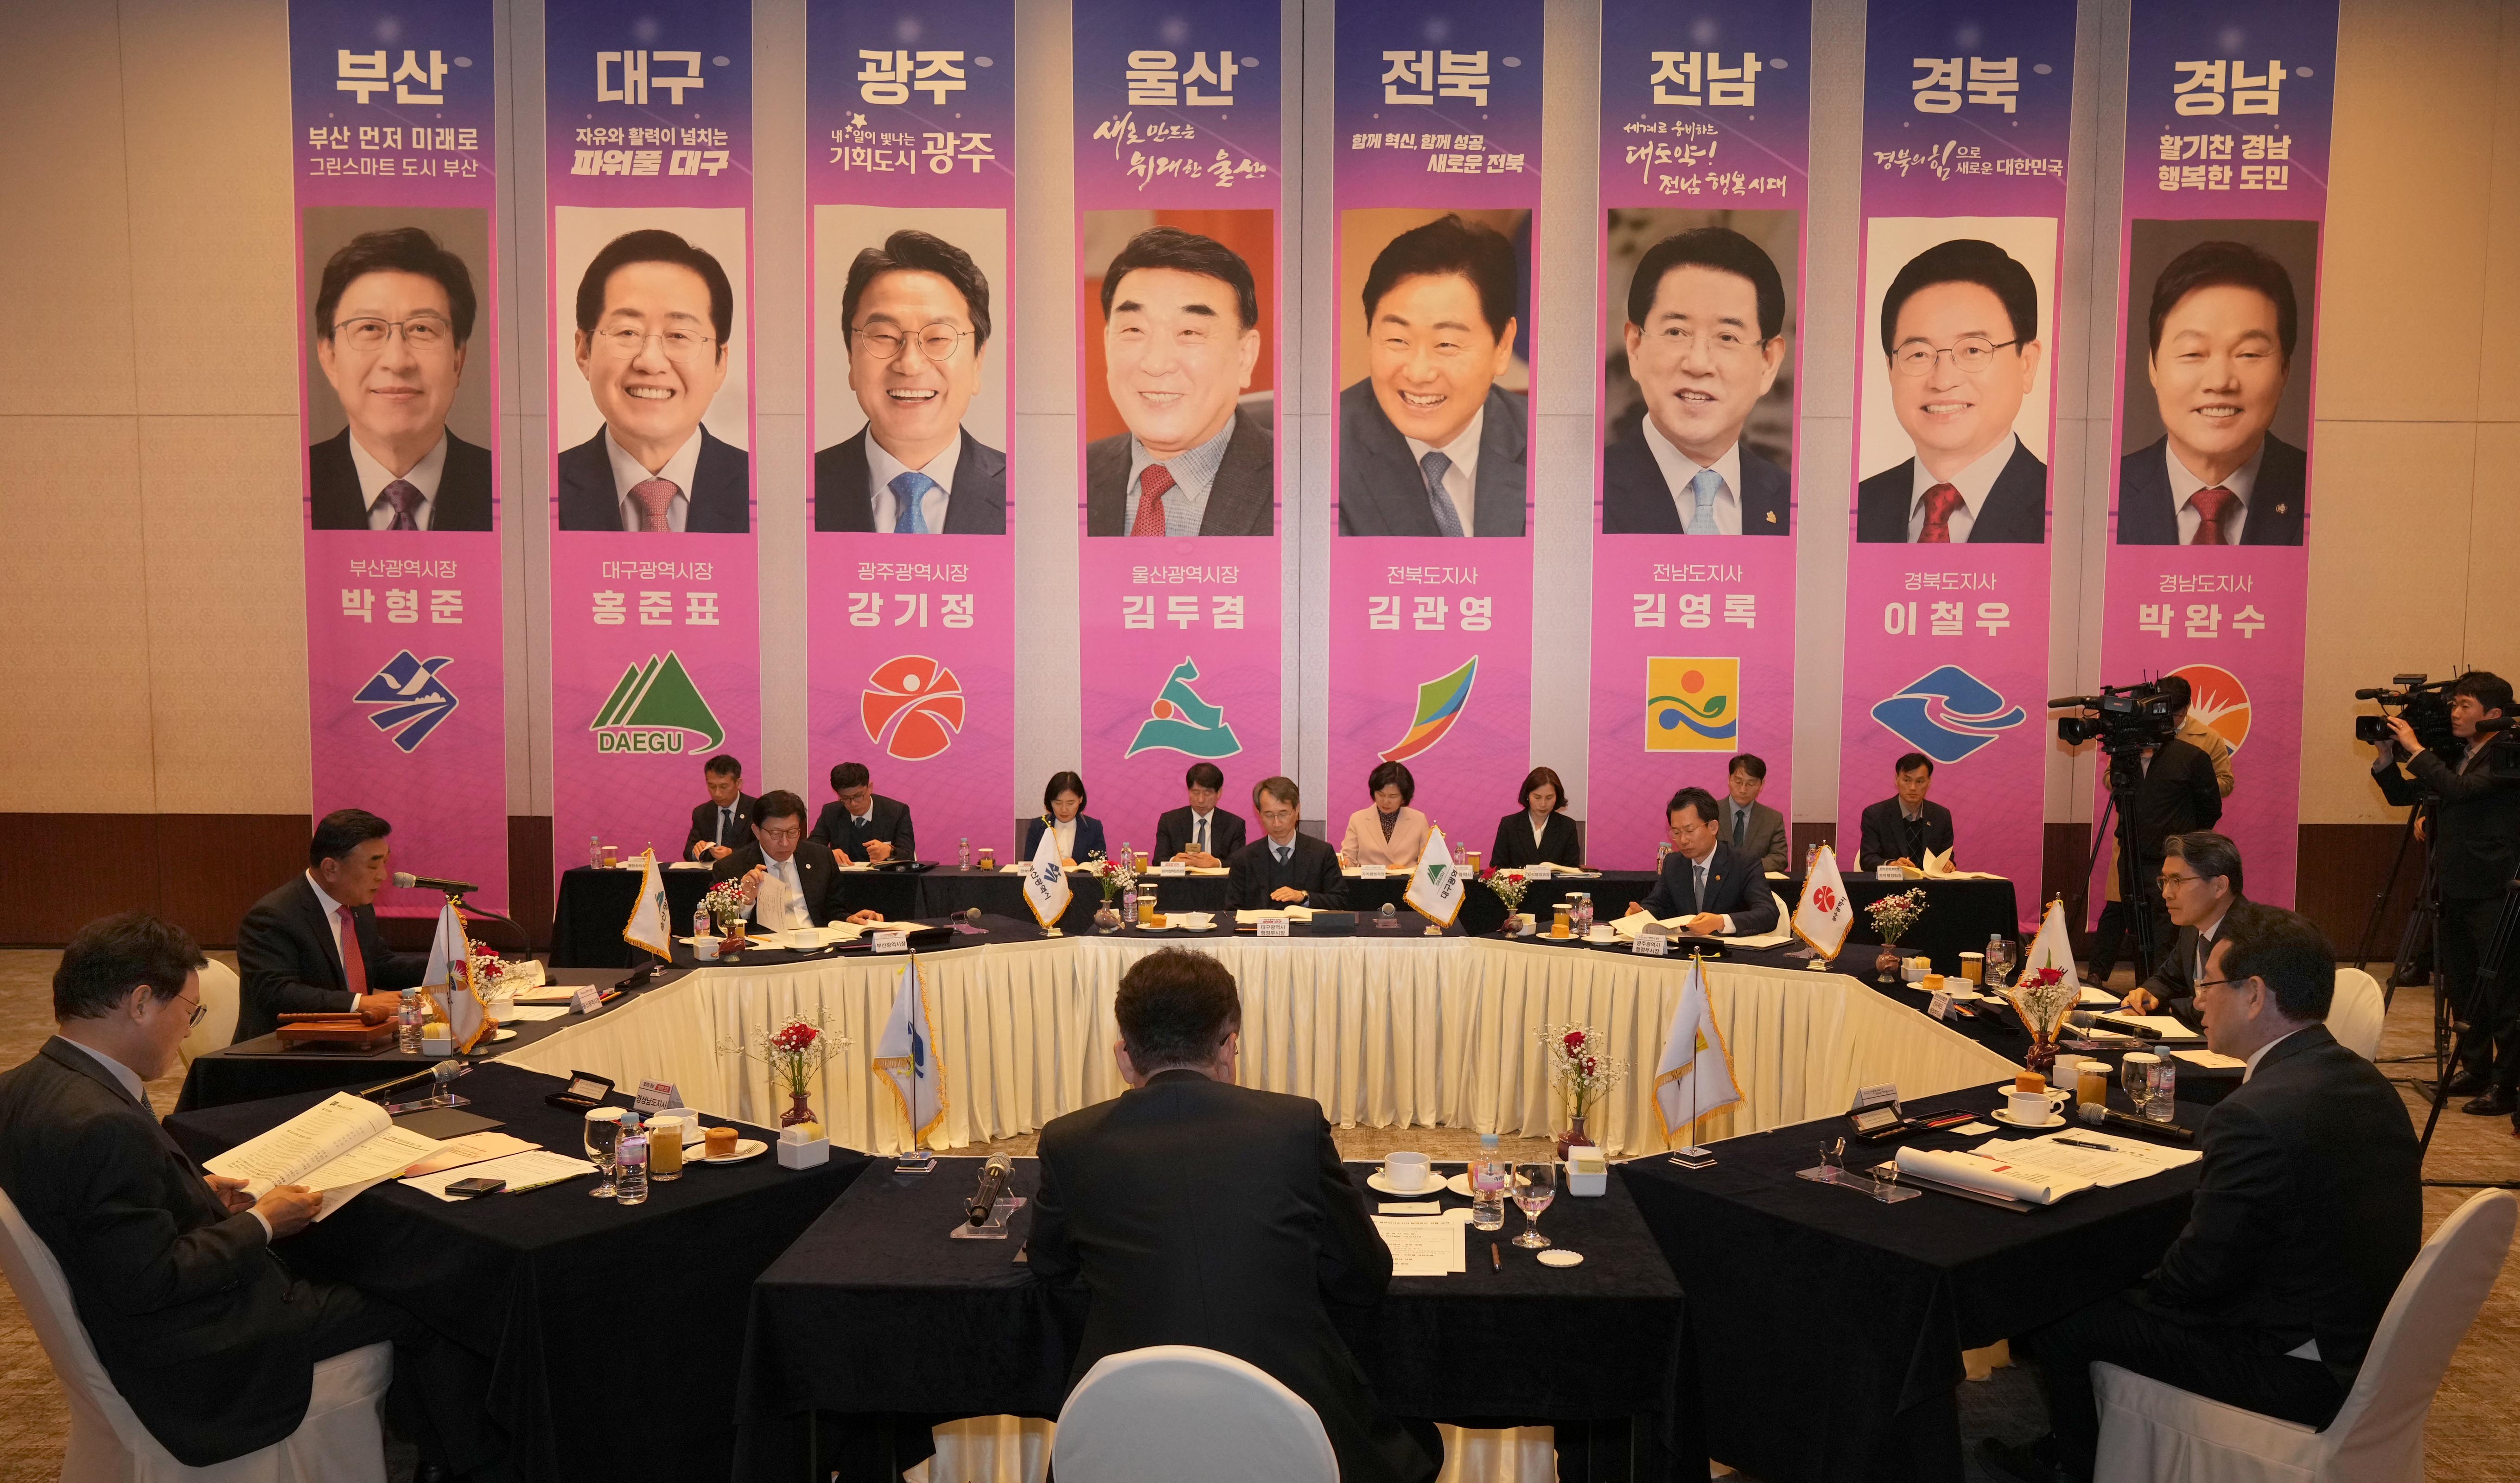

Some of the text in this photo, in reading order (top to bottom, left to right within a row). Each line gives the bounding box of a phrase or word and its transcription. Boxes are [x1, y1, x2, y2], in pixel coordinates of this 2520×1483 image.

[337, 50, 447, 104] 부산
[597, 51, 704, 104] 대구
[858, 50, 966, 104] 광주
[1126, 51, 1238, 105] 울산
[1382, 51, 1489, 106] 전북
[1651, 51, 1761, 106] 전남
[1913, 57, 2019, 113] 경북
[2174, 60, 2286, 115] 경남
[309, 127, 477, 150] 부산 먼저 미래로
[576, 128, 728, 146] 자유와 활력이 넘치는
[881, 133, 915, 146] 빛나는
[1094, 111, 1194, 161] 새로 만드는
[1352, 133, 1486, 151] 함께 혁신, 함께 성공,
[1623, 121, 1718, 141] 세계로 웅비하는
[830, 132, 995, 174] 기회도시 광주
[2160, 134, 2291, 160] 활기찬 경남
[310, 158, 478, 177] 그린스마트 도시 부산
[571, 150, 729, 176] 파워풀 대구
[1127, 149, 1266, 191] 위대한 울산
[1427, 154, 1524, 173] 새로운 전북
[1626, 141, 1718, 185] 대도약!
[1873, 149, 1925, 177] 경북의
[1956, 158, 2063, 176] 새로운 대한민국
[1659, 174, 1701, 194] 전남
[2159, 165, 2288, 191] 행복한 도민
[350, 560, 457, 578] 부산광역시장
[603, 562, 713, 580] 대구광역시장
[858, 563, 968, 582] 광주광역시장
[1133, 566, 1239, 583] 울산광역시장
[1388, 566, 1478, 584] 전북도지사
[1654, 564, 1743, 582] 전남도지사
[1905, 573, 1997, 590] 경북도지사
[2160, 575, 2253, 592] 경남도지사
[342, 589, 463, 623] 박형준
[592, 590, 719, 625] 홍준표
[849, 593, 974, 628] 강기정
[1123, 596, 1243, 629] 김두겸
[1369, 596, 1491, 631] 김관영
[1634, 594, 1756, 628] 김영록
[1885, 601, 2010, 636] 이철우
[2139, 604, 2265, 638] 박완수
[599, 733, 683, 752] DAEGU
[1030, 865, 1051, 900] 부산광역시
[1435, 871, 1445, 886] DAEGU
[1440, 866, 1458, 899] 대구광역
[1832, 896, 1847, 921] 광주광역시
[582, 997, 600, 1010] 울산광역시장
[636, 1095, 668, 1110] 경상남도지사
